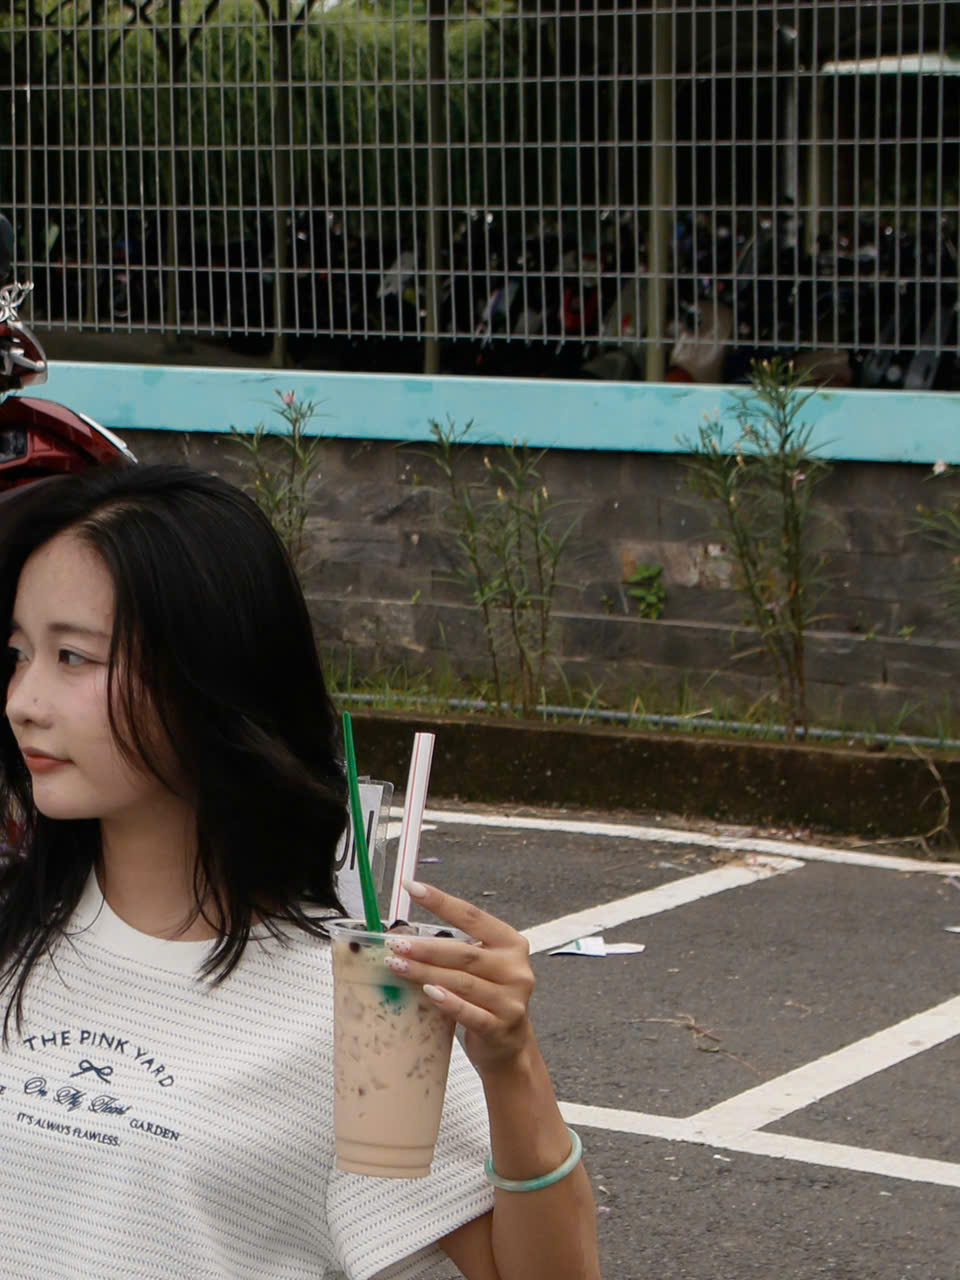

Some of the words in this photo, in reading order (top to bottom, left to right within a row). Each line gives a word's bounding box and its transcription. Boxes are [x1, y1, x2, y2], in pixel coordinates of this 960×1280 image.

[24, 1030, 71, 1051] THE
[80, 1030, 129, 1053] PINK
[135, 1047, 175, 1088] YARD
[17, 1112, 34, 1126] IT'S
[35, 1118, 71, 1136] ALWAYS
[129, 1119, 180, 1141] GARDEN
